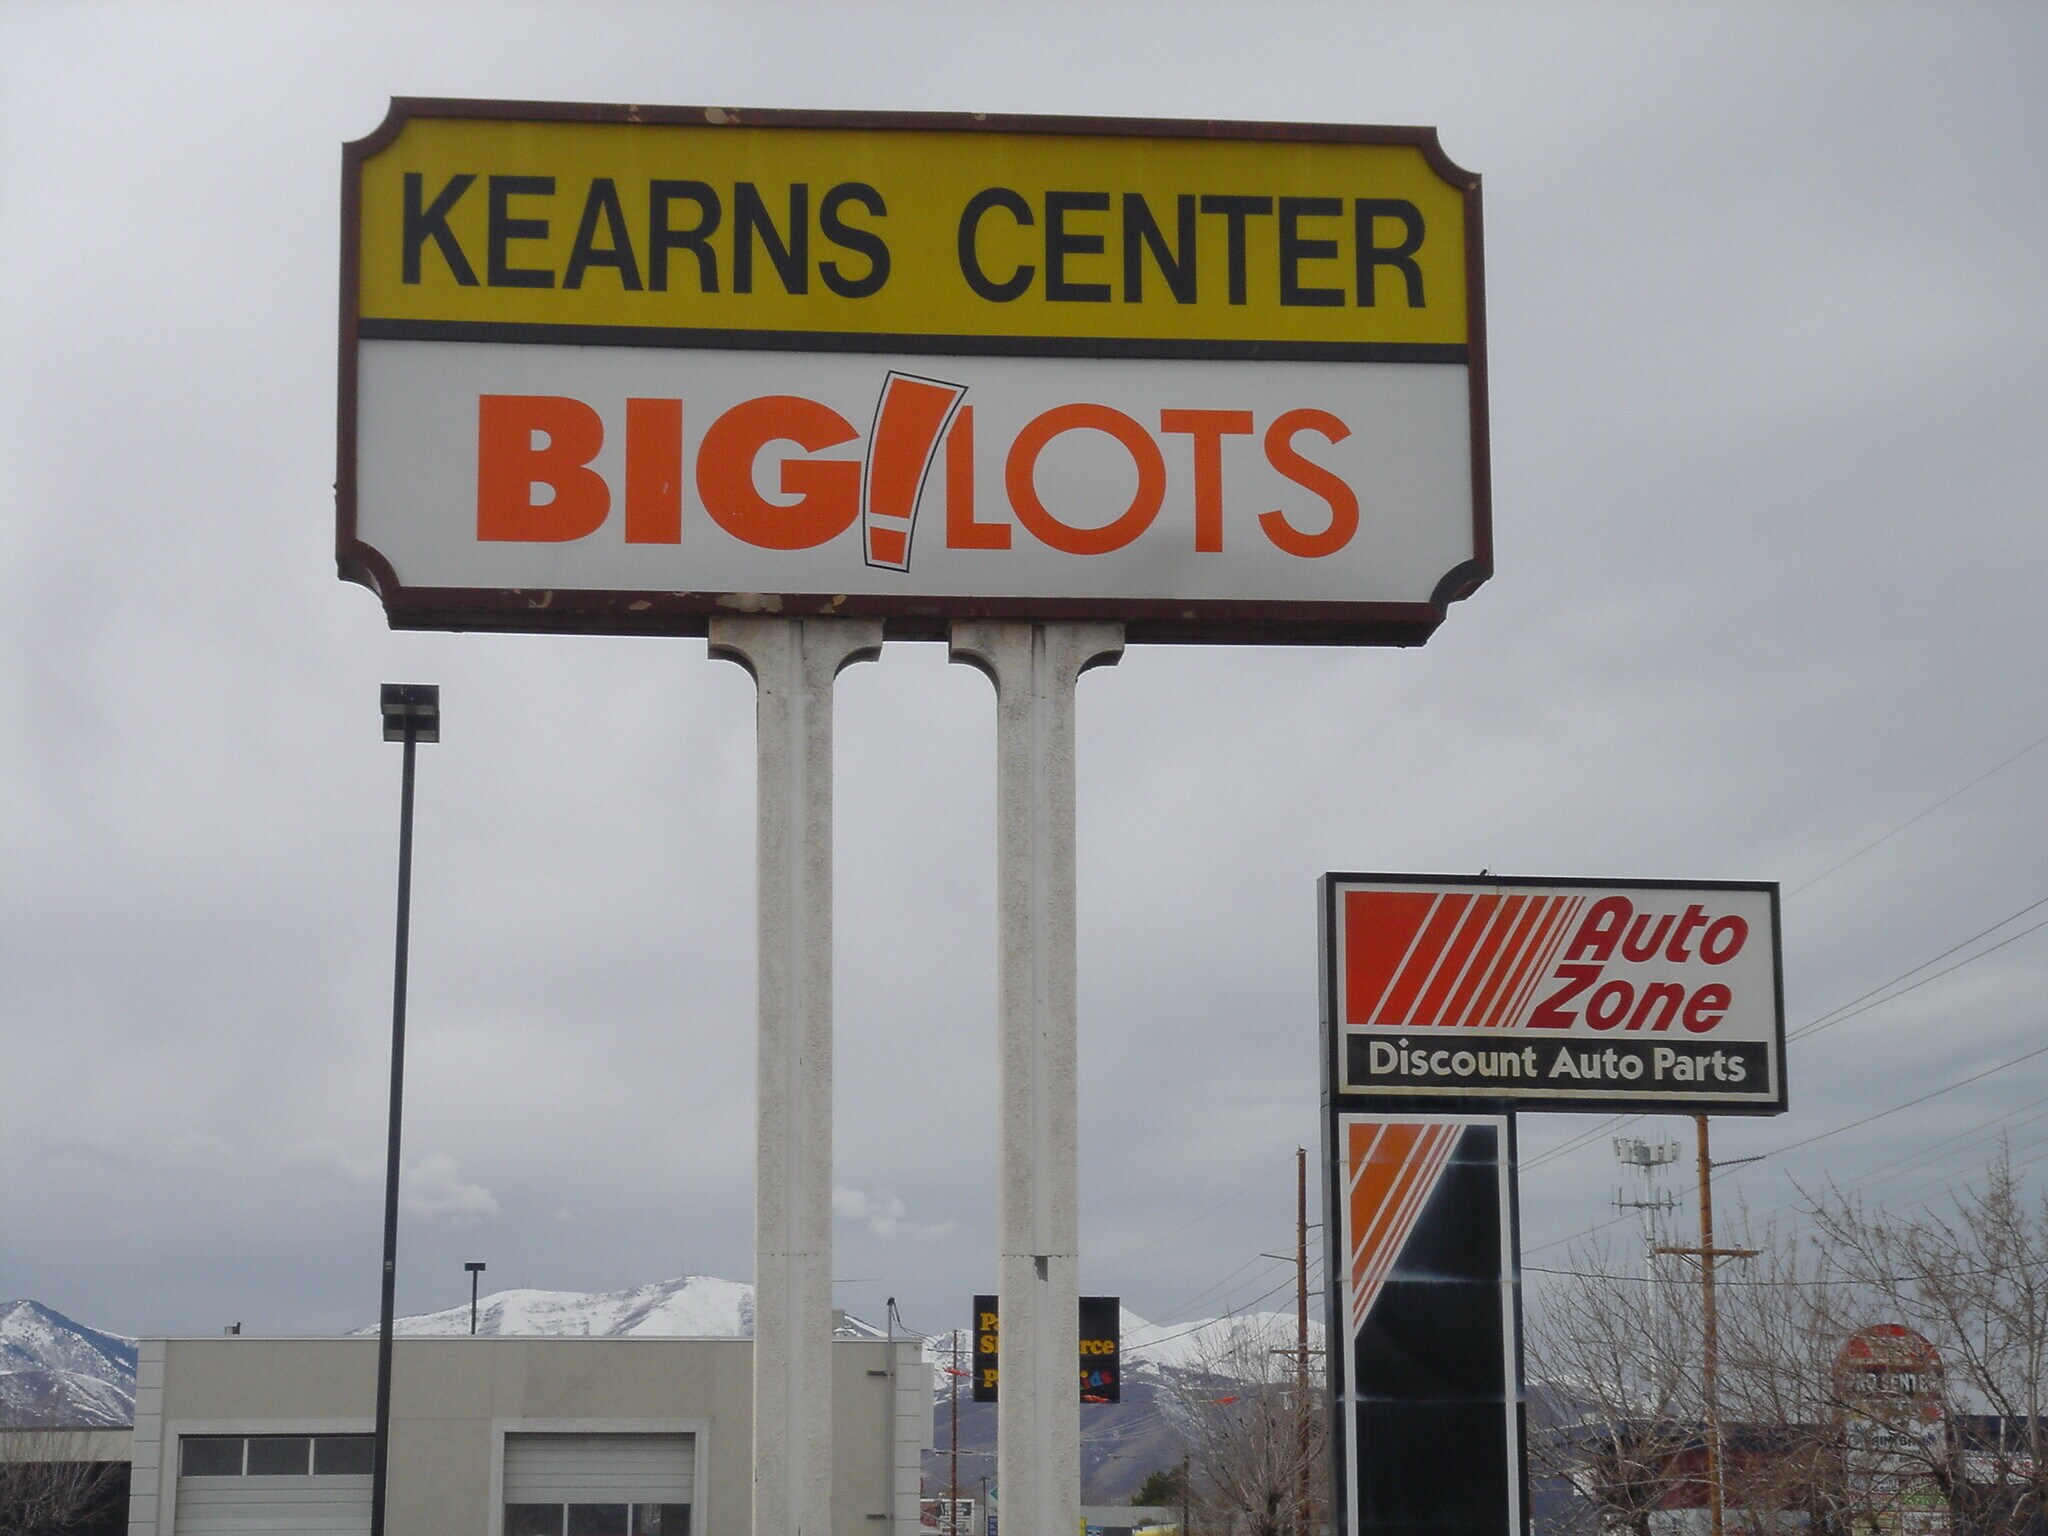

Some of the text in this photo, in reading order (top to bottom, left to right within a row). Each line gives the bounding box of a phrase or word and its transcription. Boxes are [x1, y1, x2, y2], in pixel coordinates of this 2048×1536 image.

[402, 172, 1426, 309] KEARNS CENTER
[1563, 895, 1749, 965] Auto
[1526, 964, 1732, 1034] Zone
[1369, 1037, 1747, 1083] Discount Auto Parts
